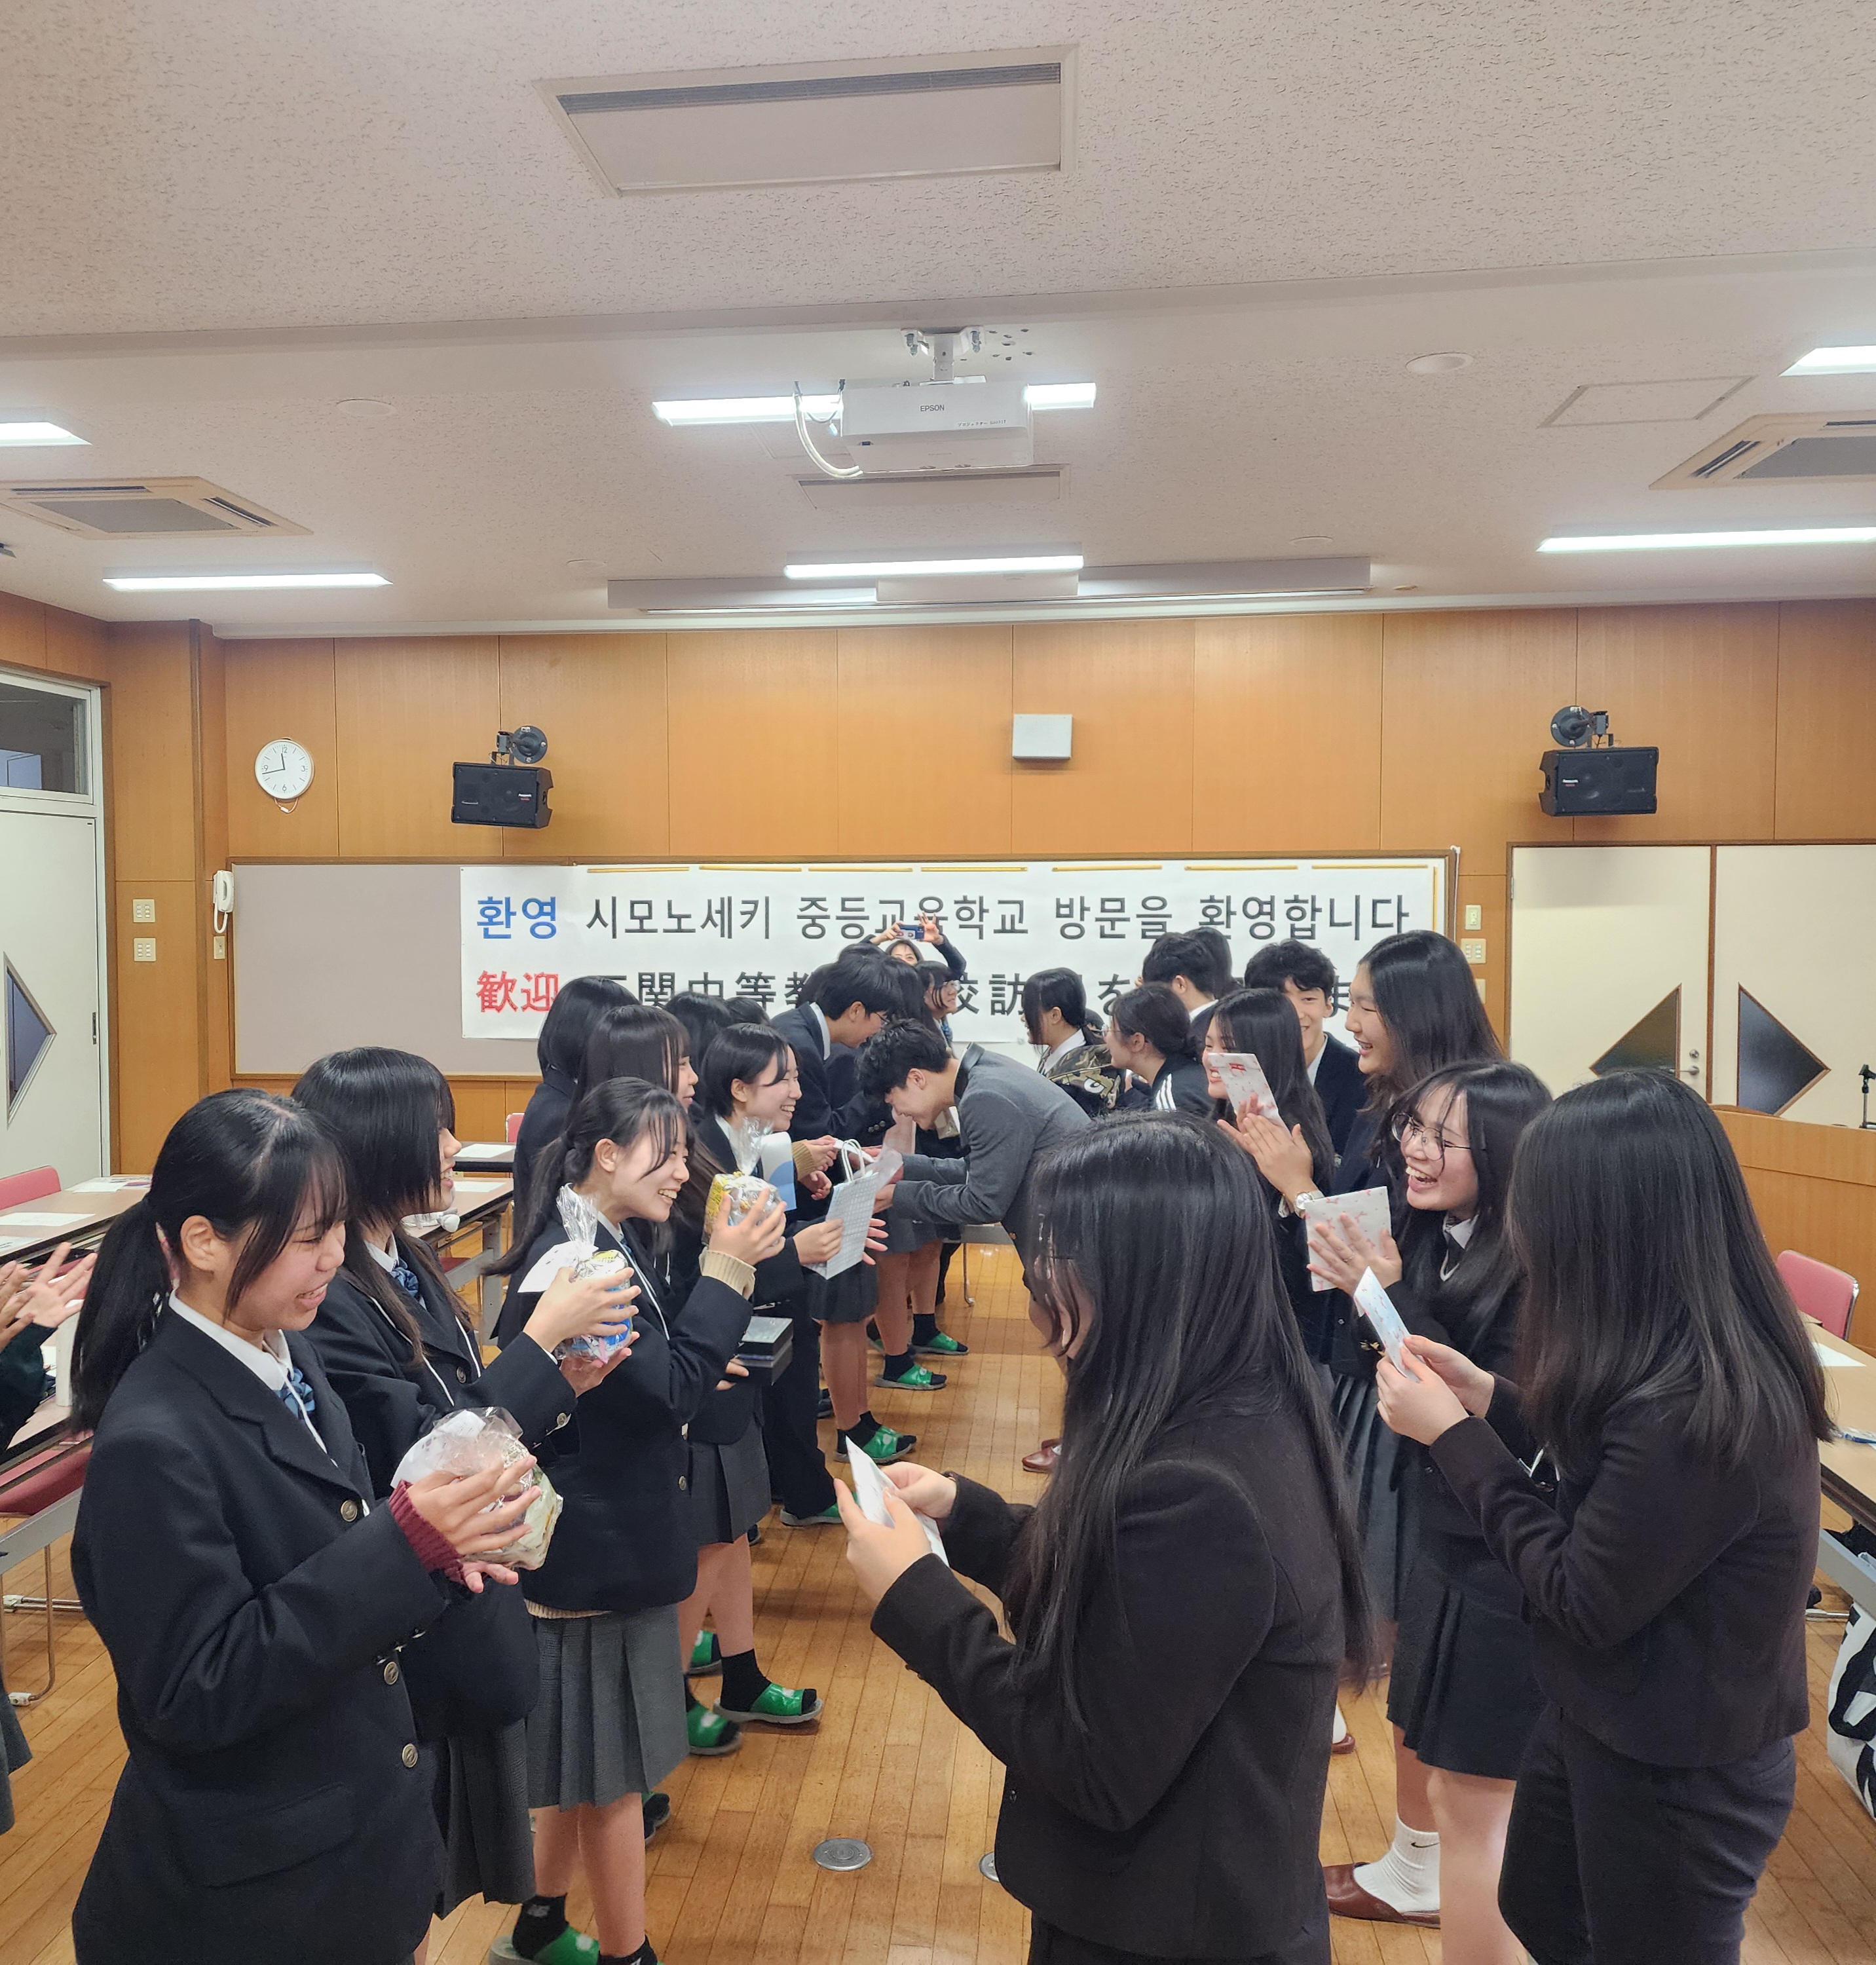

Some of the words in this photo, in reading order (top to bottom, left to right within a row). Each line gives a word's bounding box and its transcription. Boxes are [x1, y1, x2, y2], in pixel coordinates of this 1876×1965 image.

[476, 895, 557, 939] 환영
[586, 895, 770, 939] 시모노세키
[1056, 895, 1172, 939] 방문을
[1199, 894, 1410, 941] 환영합니다
[476, 970, 559, 1013] 歓迎
